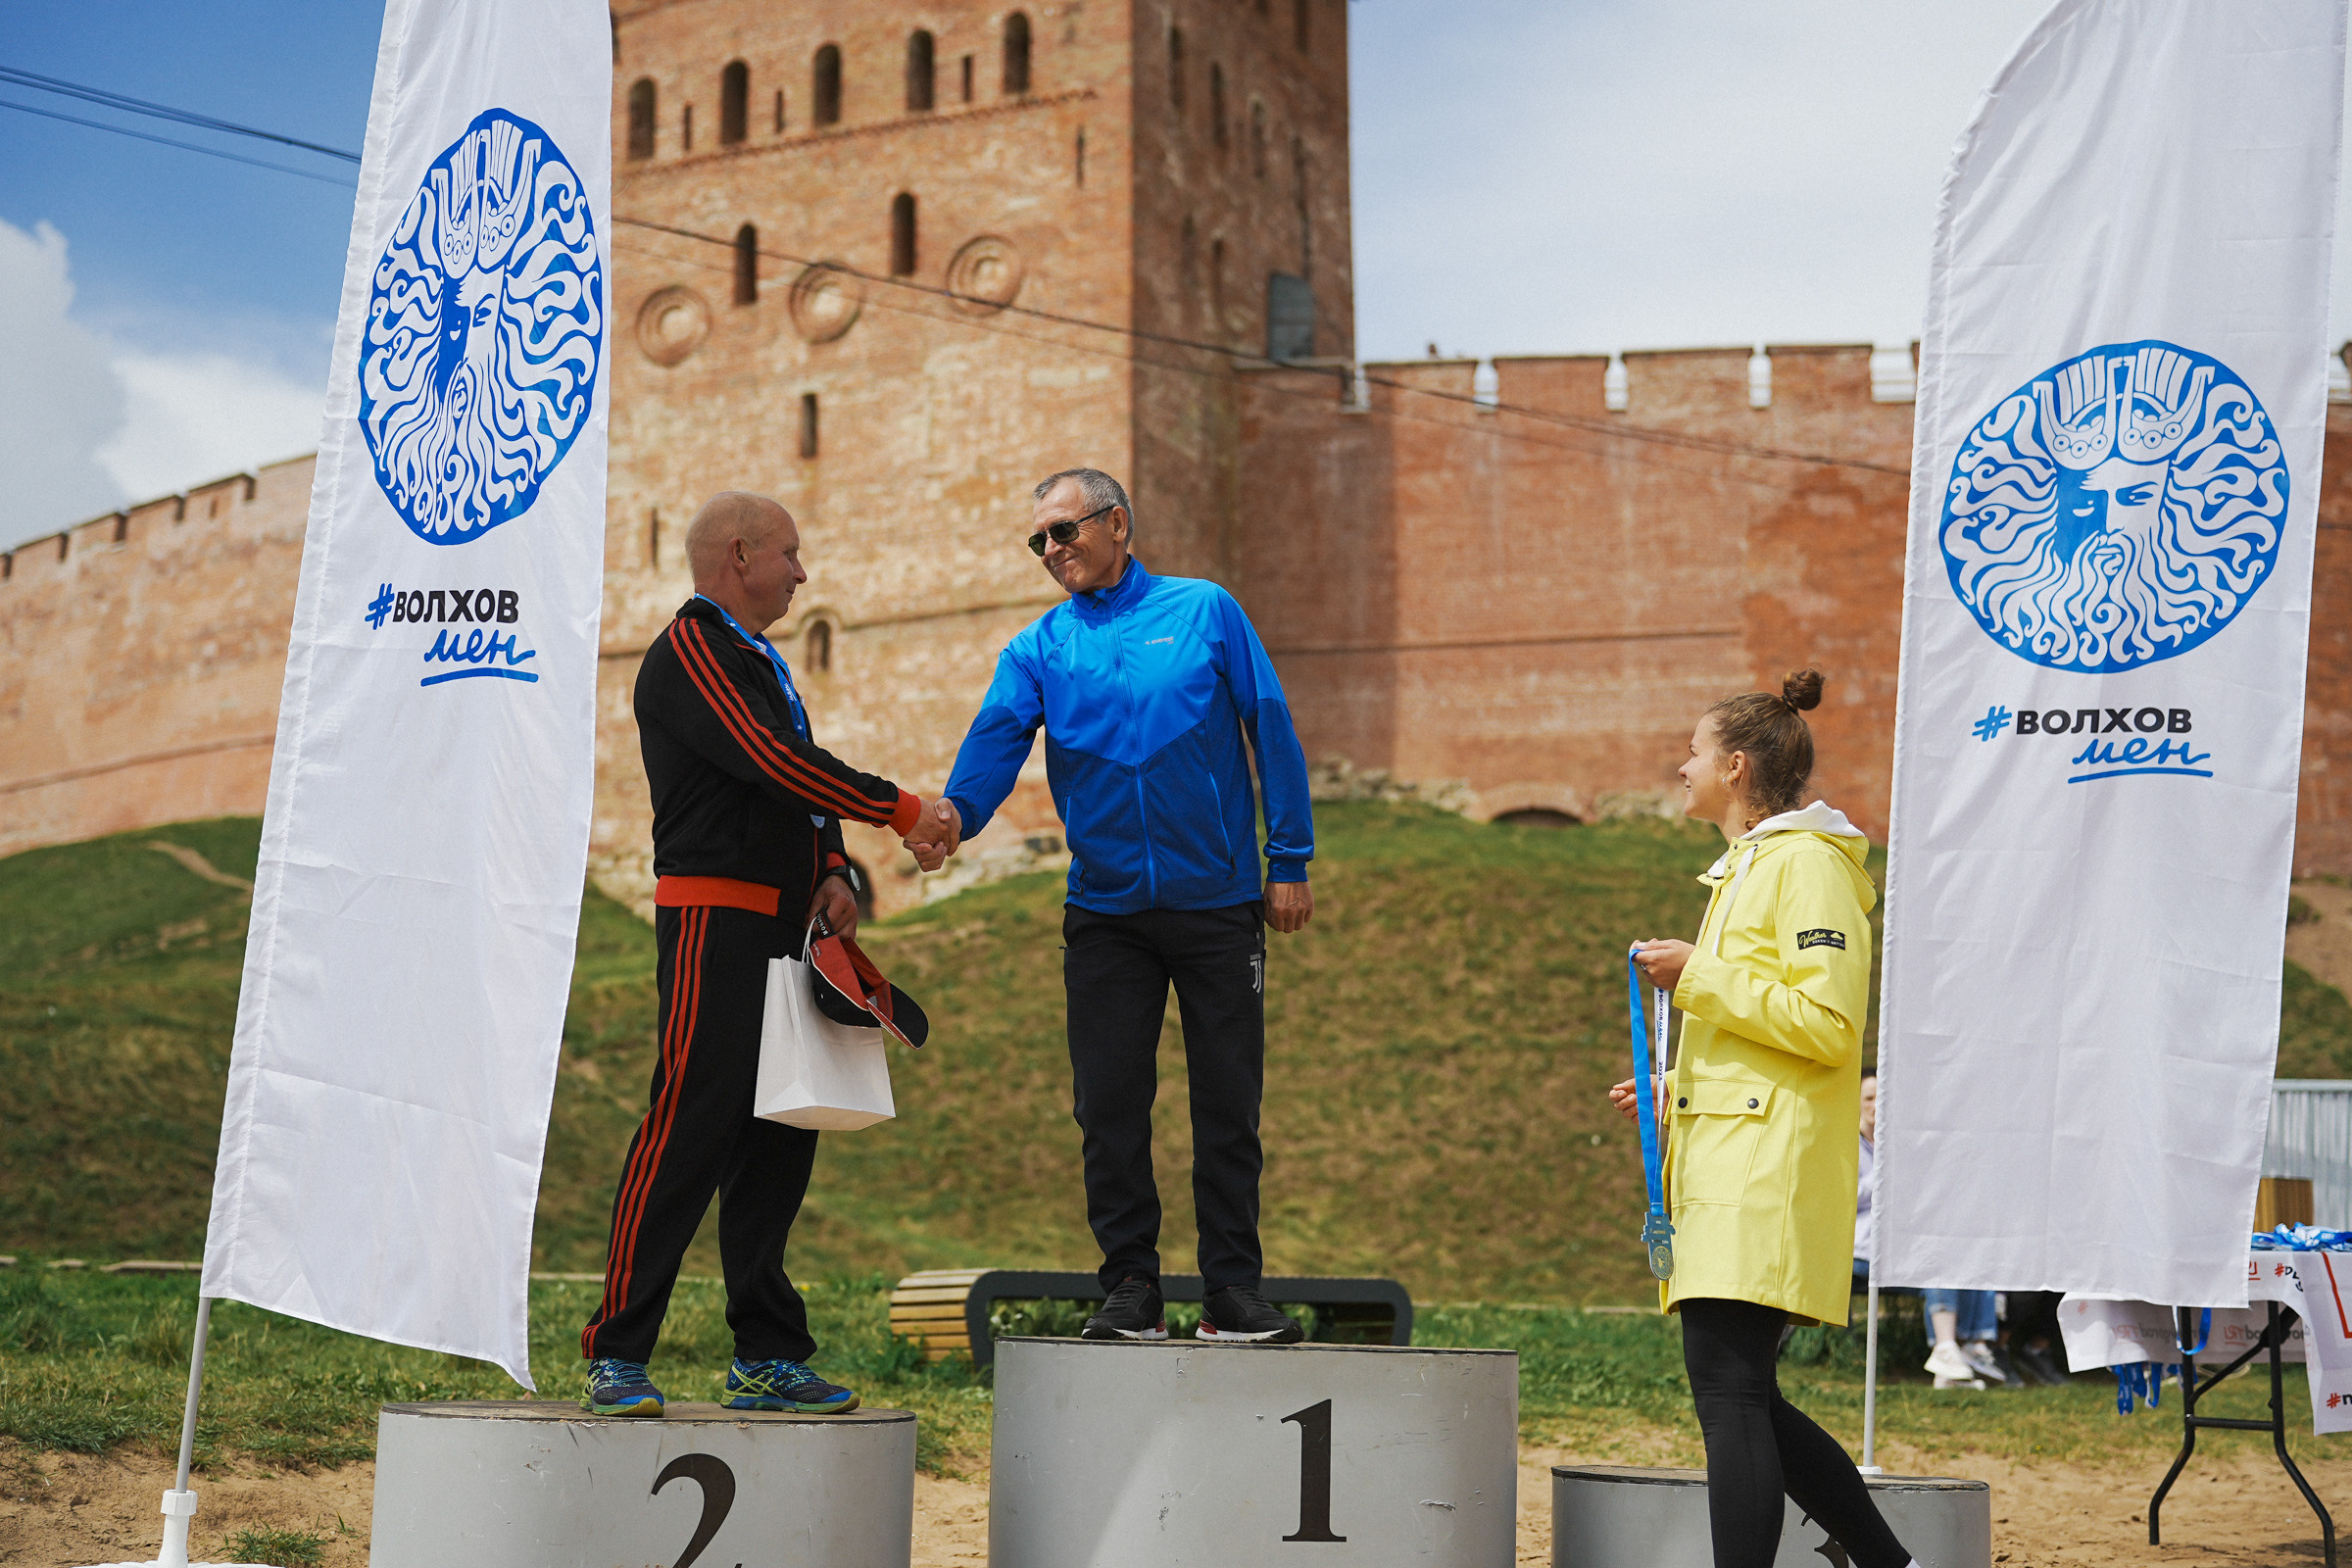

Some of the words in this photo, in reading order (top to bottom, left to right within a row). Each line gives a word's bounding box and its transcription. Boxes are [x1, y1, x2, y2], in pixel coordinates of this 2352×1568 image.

[365, 582, 519, 630] #ВОЛХОВ
[423, 628, 537, 666] мен
[1972, 705, 2193, 742] #ВОЛХОВ
[2071, 737, 2211, 765] мен
[1280, 1398, 1348, 1543] 1
[650, 1452, 743, 1568] 2
